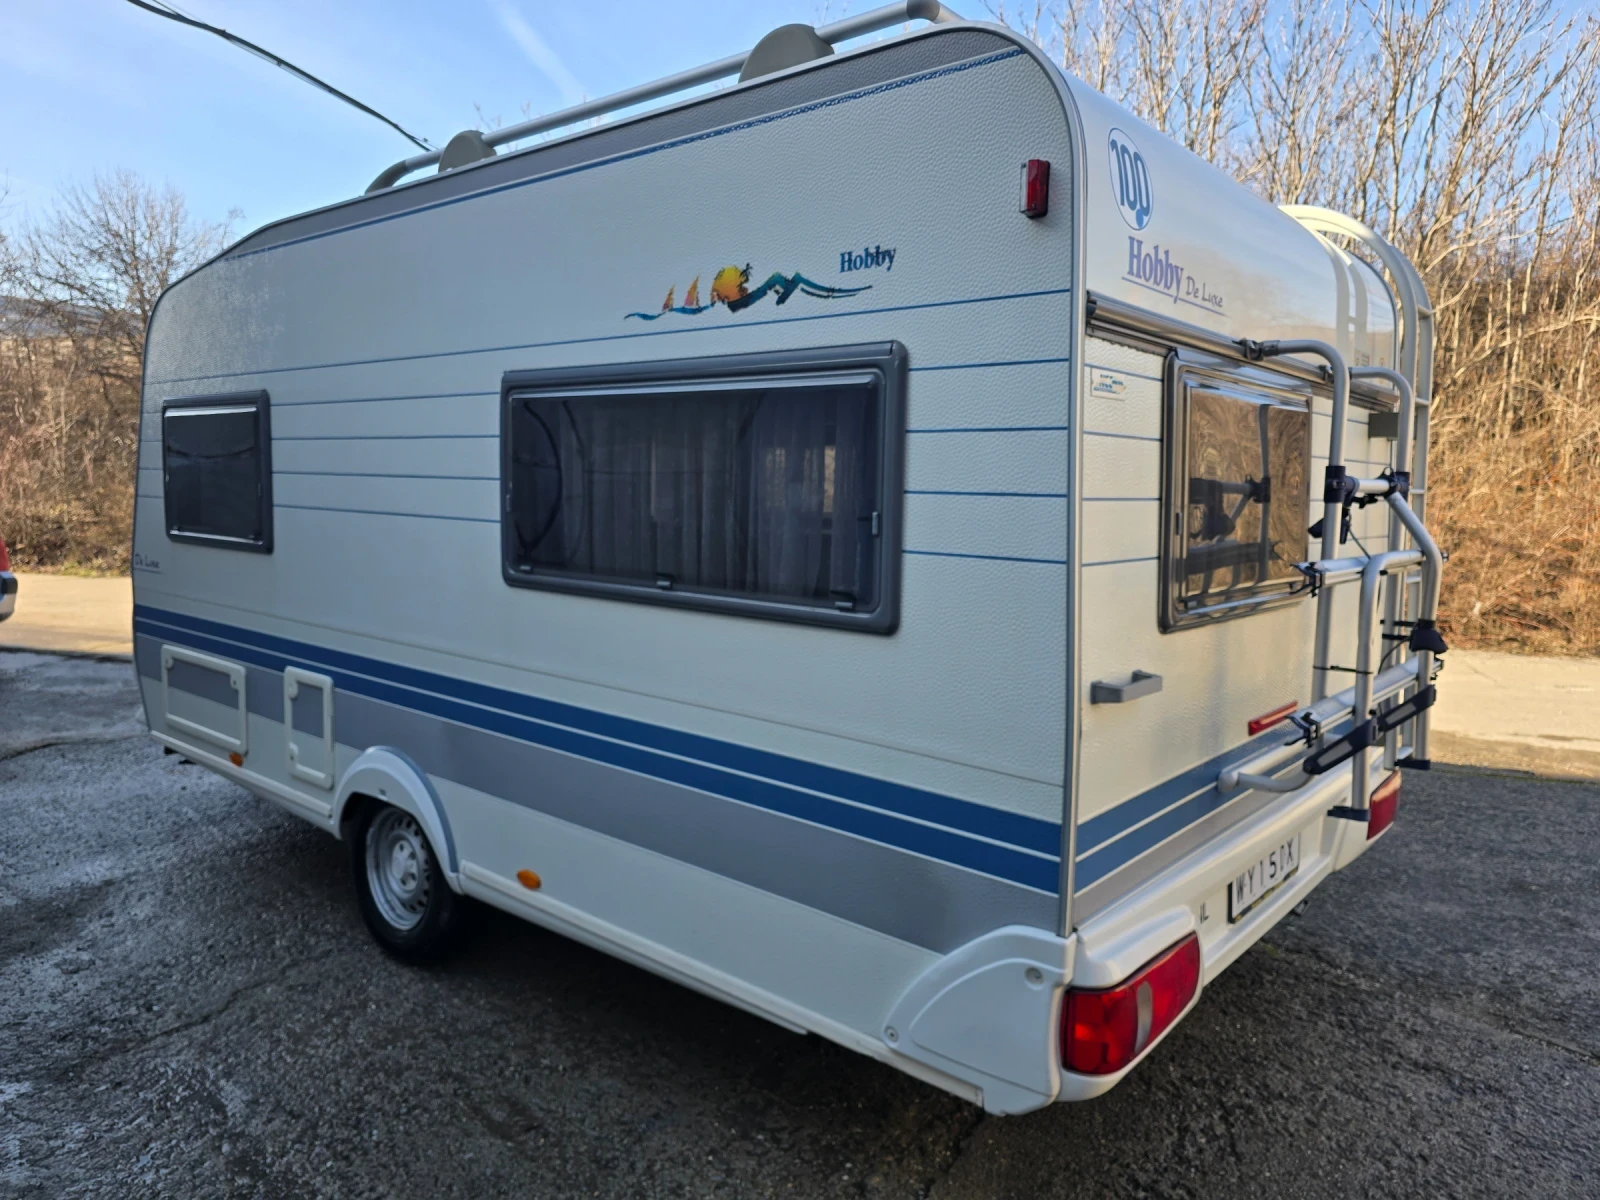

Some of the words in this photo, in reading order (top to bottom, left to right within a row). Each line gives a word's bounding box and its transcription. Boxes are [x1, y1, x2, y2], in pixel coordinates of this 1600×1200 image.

[839, 245, 896, 273] Hobby
[1127, 236, 1184, 304] Hobby
[1185, 275, 1199, 299] De
[1201, 282, 1223, 308] Luxe
